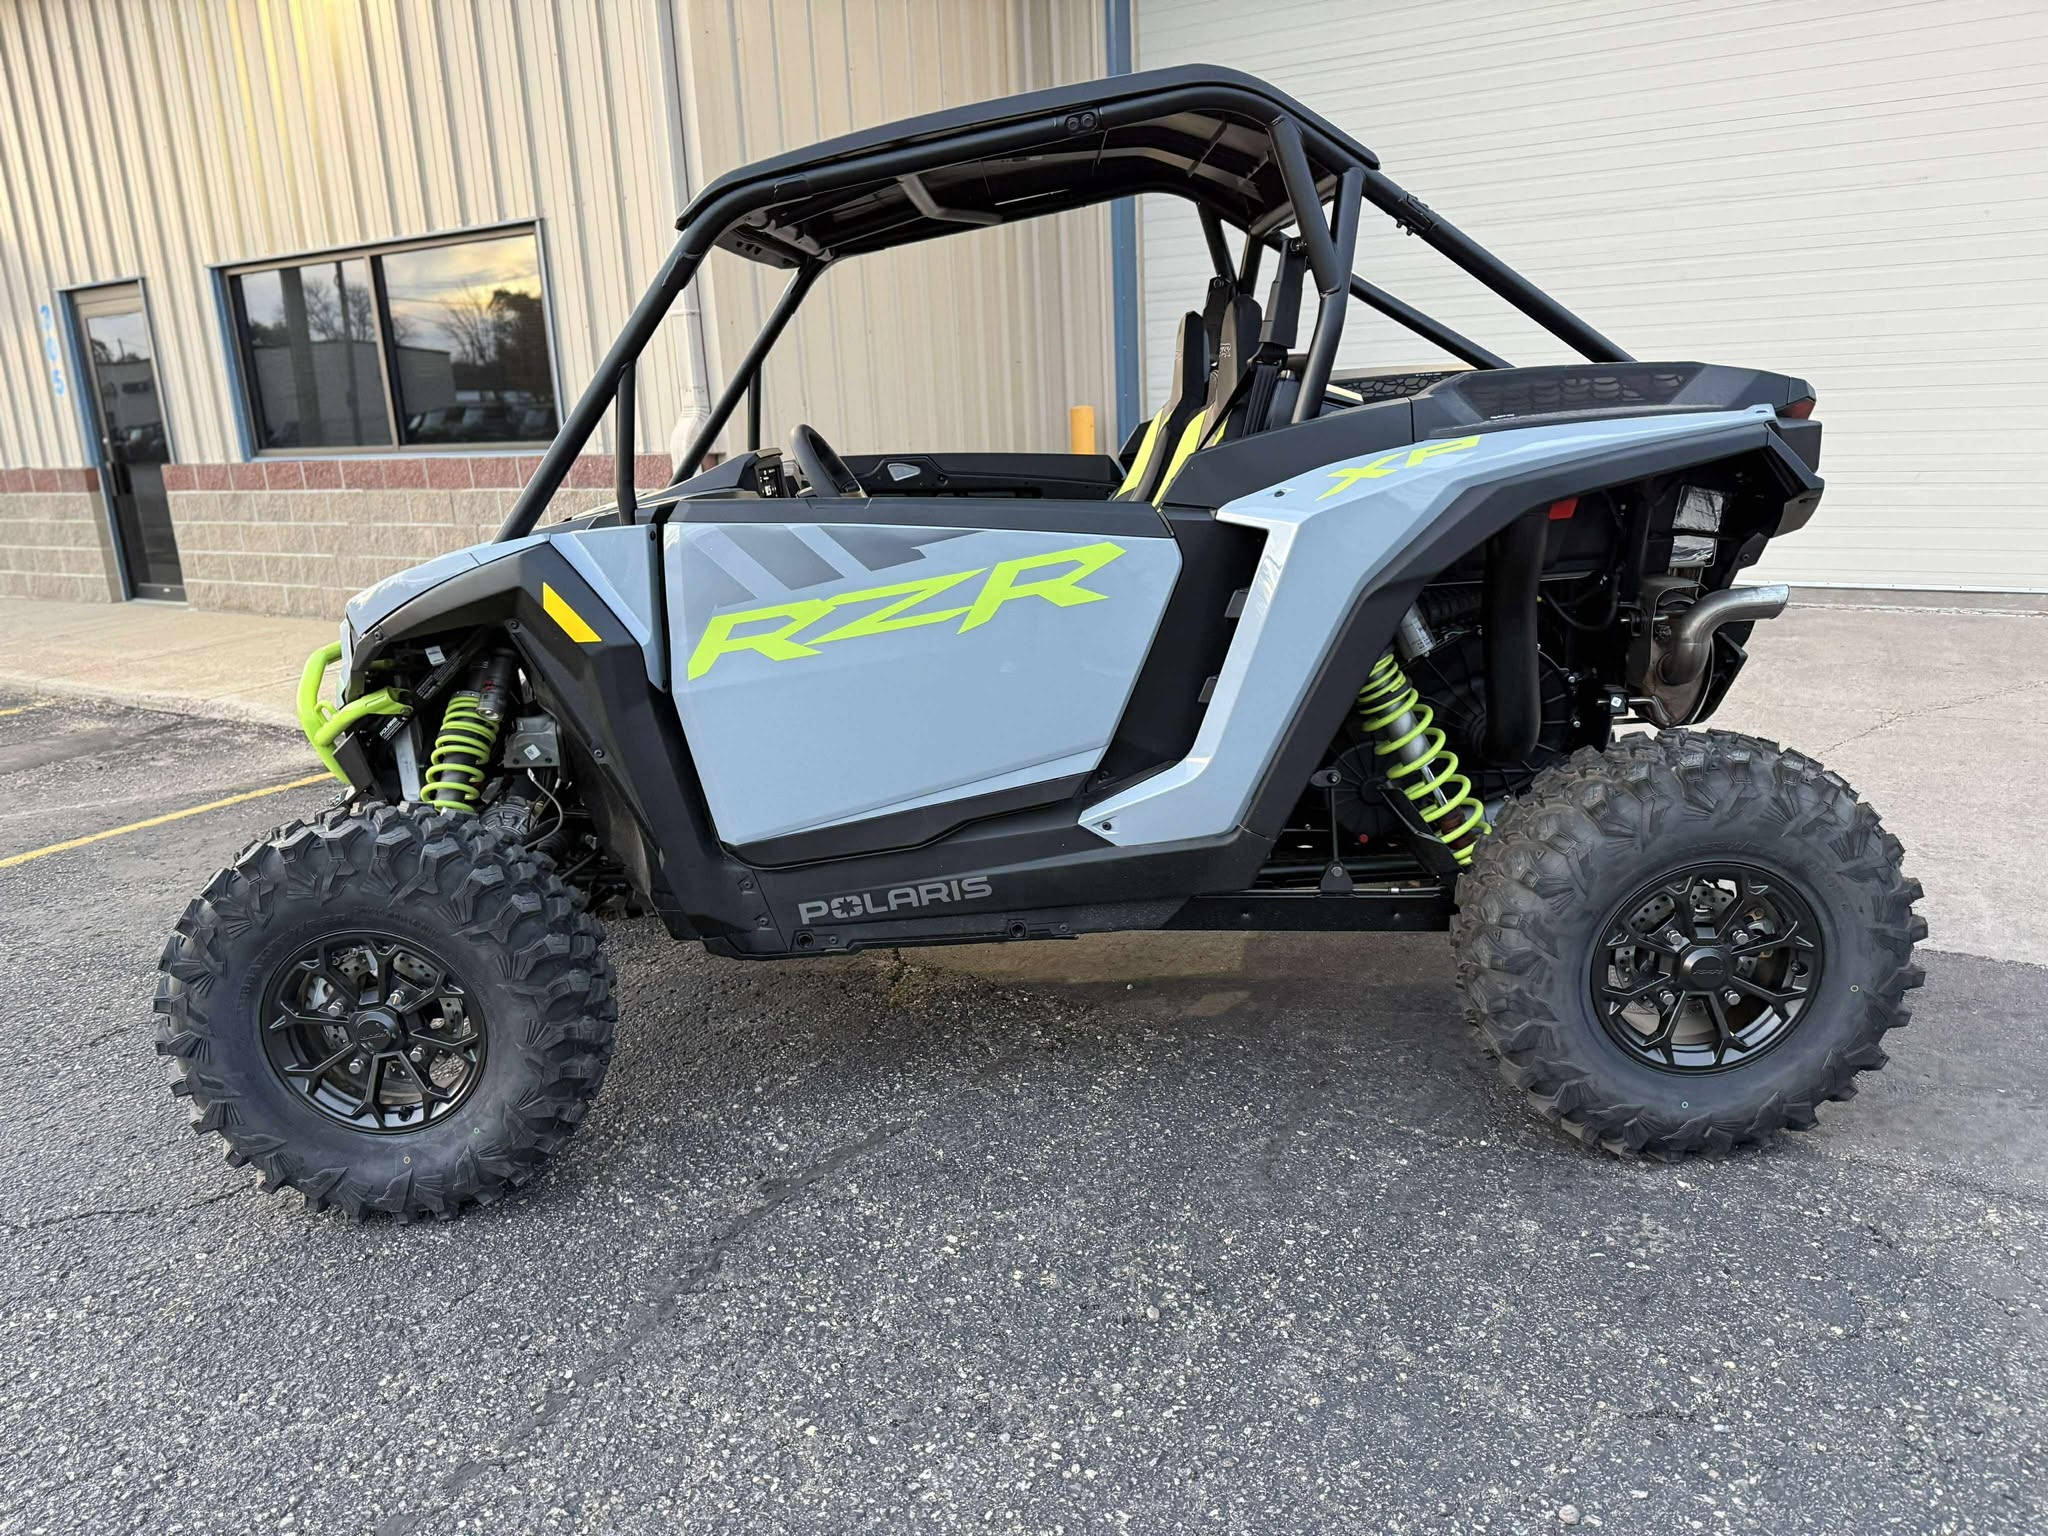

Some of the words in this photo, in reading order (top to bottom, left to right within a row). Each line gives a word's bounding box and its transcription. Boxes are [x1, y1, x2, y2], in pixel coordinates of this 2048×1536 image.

[1315, 436, 1481, 502] XP
[688, 541, 1127, 681] RZR
[798, 875, 993, 925] POLARIS
